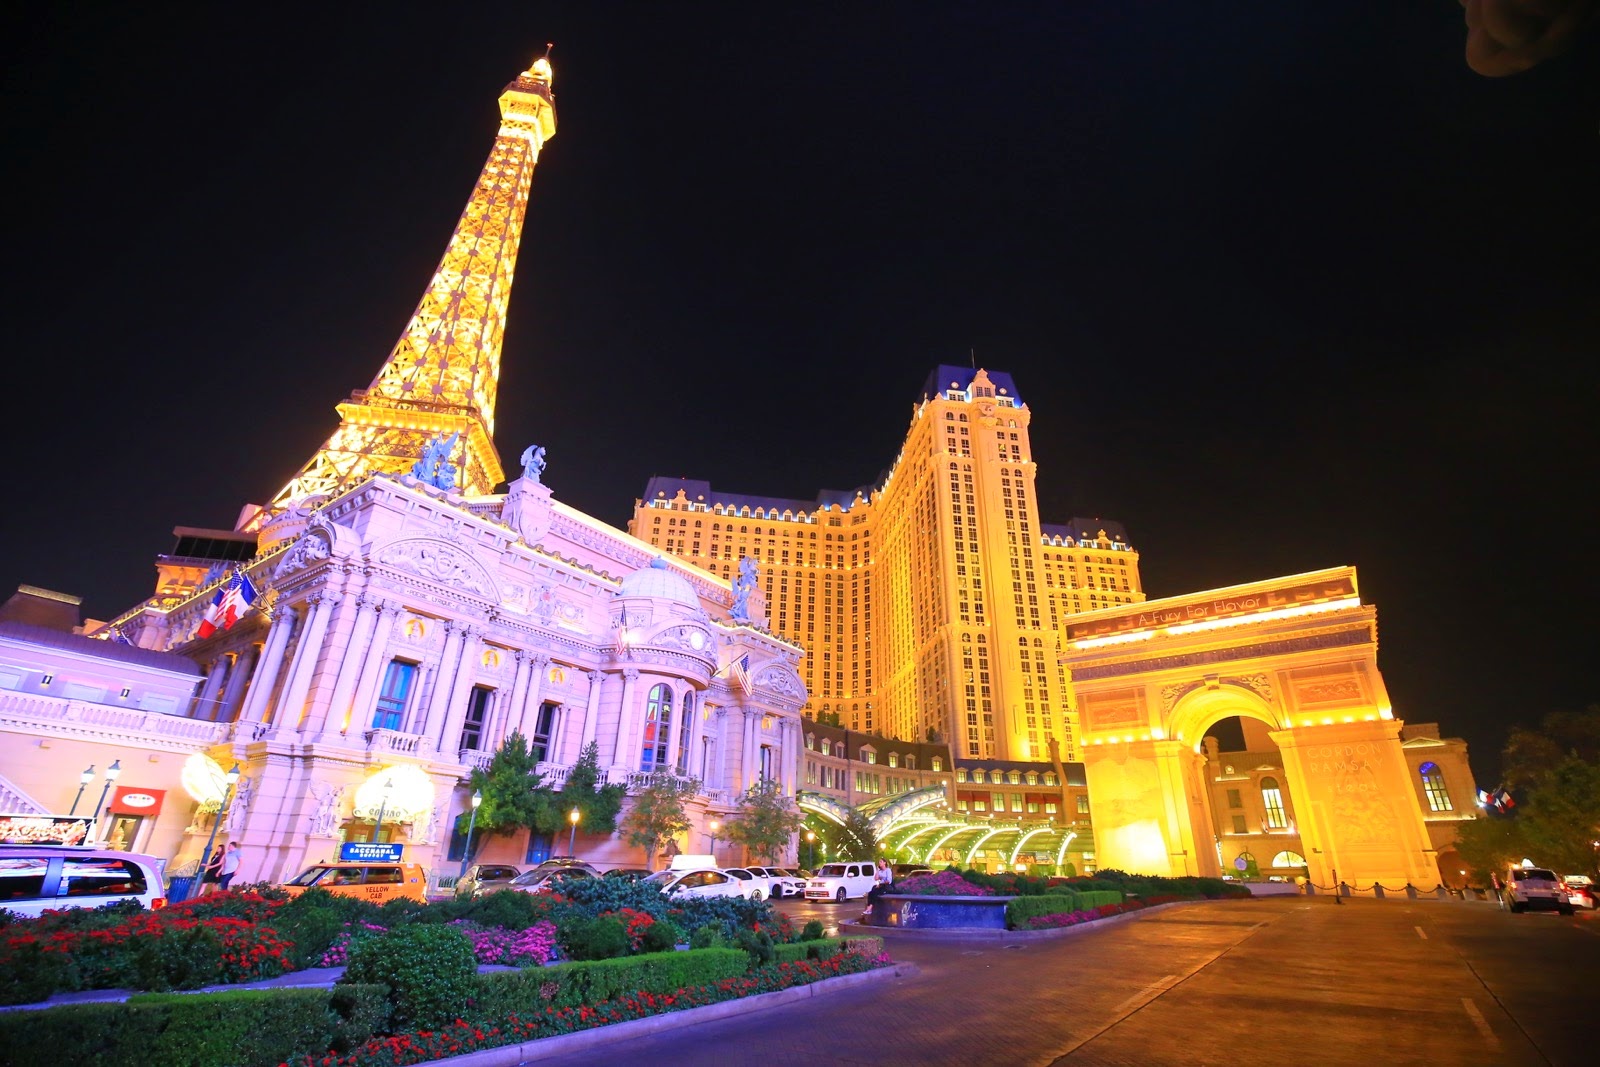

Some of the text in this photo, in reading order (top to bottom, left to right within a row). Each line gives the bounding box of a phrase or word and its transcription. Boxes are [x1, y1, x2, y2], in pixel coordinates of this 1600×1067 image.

[1138, 598, 1261, 626] A Fury For Flavor
[1310, 758, 1383, 773] RAMSAY
[369, 892, 383, 900] CAB
